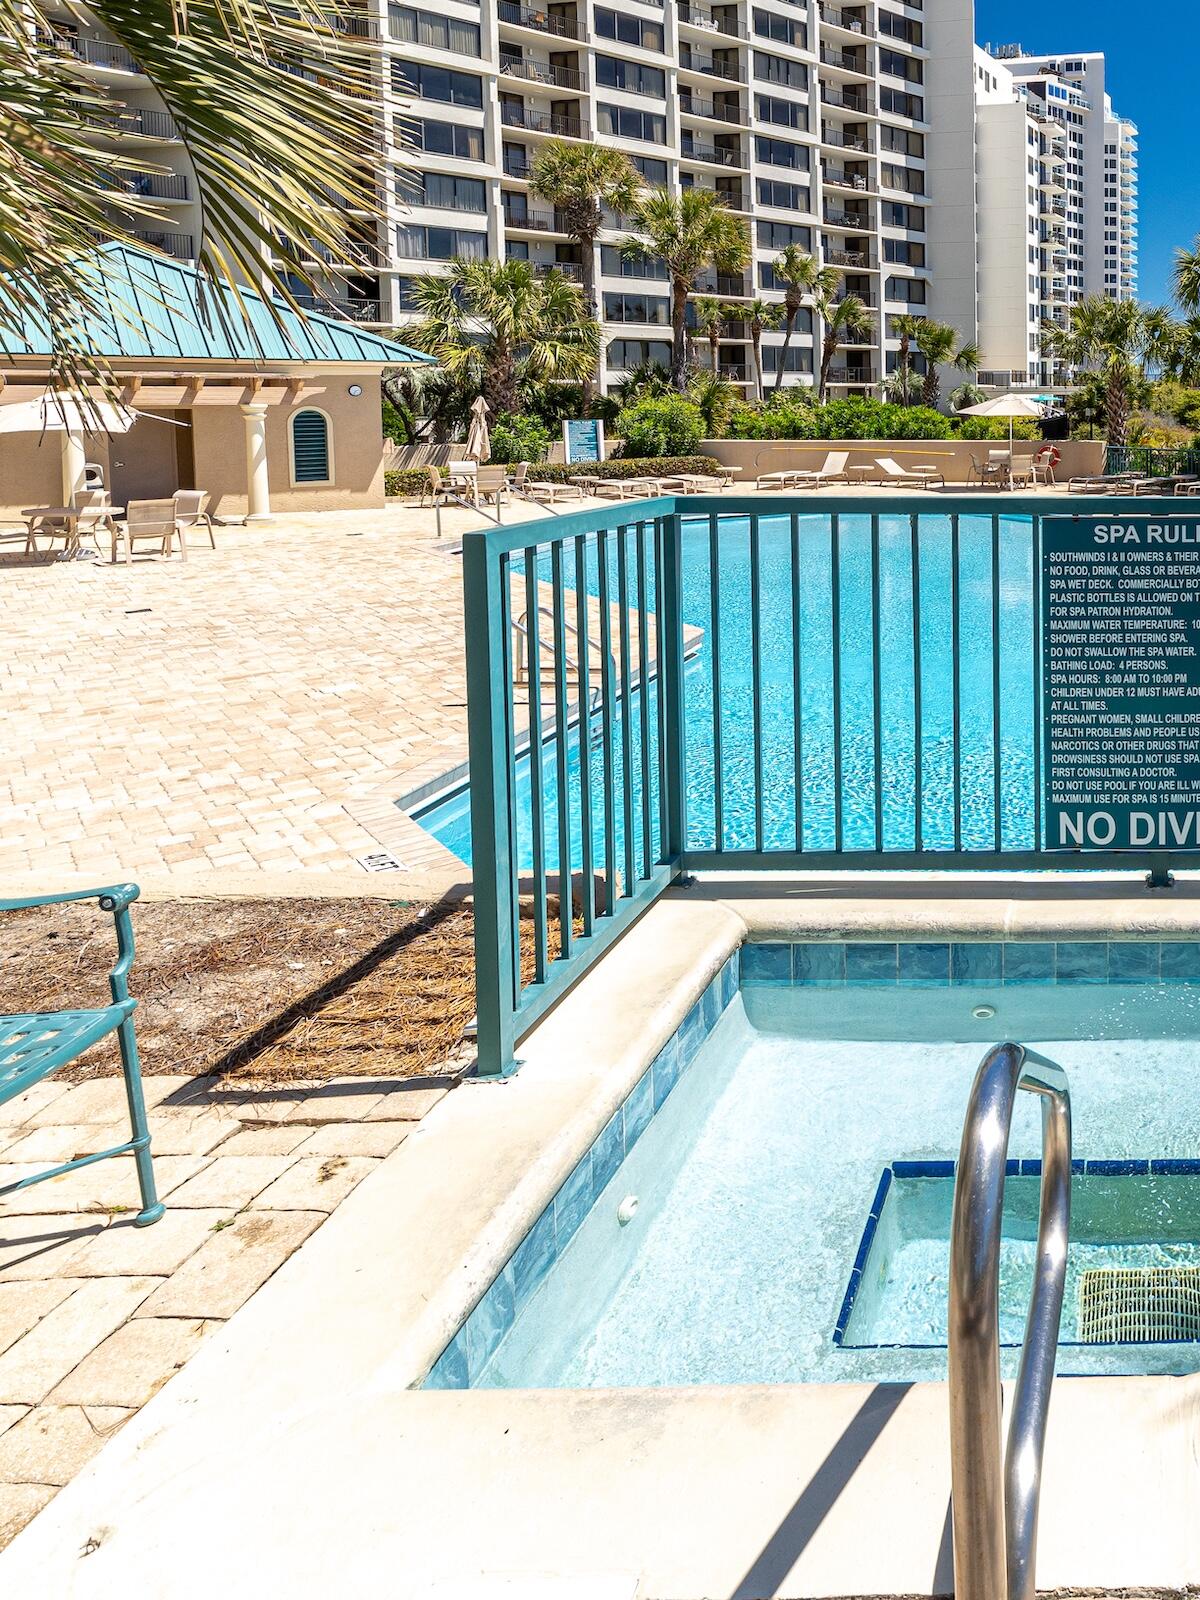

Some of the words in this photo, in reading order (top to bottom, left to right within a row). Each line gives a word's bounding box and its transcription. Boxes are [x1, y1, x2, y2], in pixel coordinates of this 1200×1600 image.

[1094, 525, 1140, 543] SPA
[1050, 552, 1105, 562] SOUTHWINDS
[1107, 552, 1110, 561] I
[1112, 552, 1118, 561] &
[1120, 552, 1125, 561] II
[1127, 552, 1164, 561] OWNERS
[1166, 552, 1172, 561] &
[1174, 552, 1199, 561] THEIR
[1050, 566, 1062, 575] NO
[1064, 566, 1090, 577] FOOD,
[1092, 566, 1120, 576] DRINK,
[1122, 565, 1151, 574] GLASS
[1153, 565, 1165, 574] OR
[1050, 580, 1067, 589] SPA
[1068, 579, 1086, 589] WET
[1088, 579, 1114, 589] DECK.
[1118, 579, 1184, 588] COMMERCIALLY
[1050, 593, 1085, 602] PLASTIC
[1087, 593, 1125, 602] BOTTLES
[1127, 593, 1135, 602] IS
[1137, 592, 1178, 602] ALLOWED
[1180, 592, 1193, 602] ON
[1050, 607, 1068, 616] FOR
[1069, 607, 1086, 616] SPA
[1088, 606, 1121, 616] PATRON
[1123, 606, 1173, 616] HYDRATION.
[1050, 620, 1090, 630] MAXIMUM
[1092, 620, 1121, 629] WATER
[1123, 620, 1187, 629] TEMPERATURE:
[1050, 634, 1087, 643] SHOWER
[1089, 634, 1123, 643] BEFORE
[1125, 633, 1167, 643] ENTERING
[1169, 633, 1188, 642] SPA.
[1050, 648, 1063, 657] DO
[1065, 647, 1082, 657] NOT
[1084, 647, 1127, 656] SWALLOW
[1129, 647, 1145, 656] THE
[1147, 647, 1164, 656] SPA
[1165, 646, 1197, 656] WATER.
[1051, 661, 1087, 670] BATHING
[1089, 661, 1115, 670] LOAD:
[1119, 661, 1124, 670] 4
[1126, 660, 1168, 670] PERSONS.
[1050, 674, 1067, 684] SPA
[1068, 674, 1100, 684] HOURS:
[1105, 674, 1122, 683] 8:00
[1123, 674, 1136, 683] AM
[1138, 674, 1150, 683] TO
[1152, 674, 1173, 683] 10:00
[1174, 674, 1187, 683] PM
[1051, 688, 1093, 697] CHILDREN
[1095, 687, 1124, 697] UNDER
[1126, 687, 1136, 696] 12
[1137, 687, 1161, 696] MUST
[1162, 687, 1185, 696] HAVE
[1051, 701, 1062, 710] AT
[1063, 701, 1079, 710] ALL
[1081, 701, 1108, 710] TIMES.
[1051, 714, 1097, 724] PREGNANT
[1098, 714, 1133, 725] WOMEN,
[1135, 714, 1163, 723] SMALL
[1051, 728, 1084, 737] HEALTH
[1086, 728, 1132, 737] PROBLEMS
[1133, 728, 1151, 737] AND
[1153, 727, 1186, 736] PEOPLE
[1051, 741, 1100, 750] NARCOTICS
[1102, 741, 1114, 750] OR
[1116, 741, 1145, 750] OTHER
[1147, 741, 1176, 750] DRUGS
[1178, 740, 1199, 750] THAT
[1052, 754, 1107, 764] DROWSINESS
[1109, 754, 1143, 763] SHOULD
[1145, 754, 1163, 763] NOT
[1165, 753, 1181, 763] USE
[1183, 753, 1200, 762] SPA
[1052, 768, 1076, 777] FIRST
[1077, 767, 1130, 777] CONSULTING
[1132, 767, 1138, 776] A
[1140, 767, 1177, 776] DOCTOR.
[1052, 781, 1064, 790] DO
[1066, 781, 1084, 790] NOT
[1085, 781, 1102, 790] USE
[1104, 780, 1128, 790] POOL
[1129, 780, 1137, 789] IF
[1138, 780, 1156, 789] YOU
[1158, 780, 1175, 789] ARE
[1177, 780, 1190, 789] ILL
[1052, 794, 1092, 803] MAXIMUM
[1094, 794, 1110, 803] USE
[1112, 794, 1130, 803] FOR
[1132, 794, 1148, 803] SPA
[1150, 794, 1157, 803] IS
[1160, 794, 1169, 803] 15
[1059, 811, 1116, 845] NO
